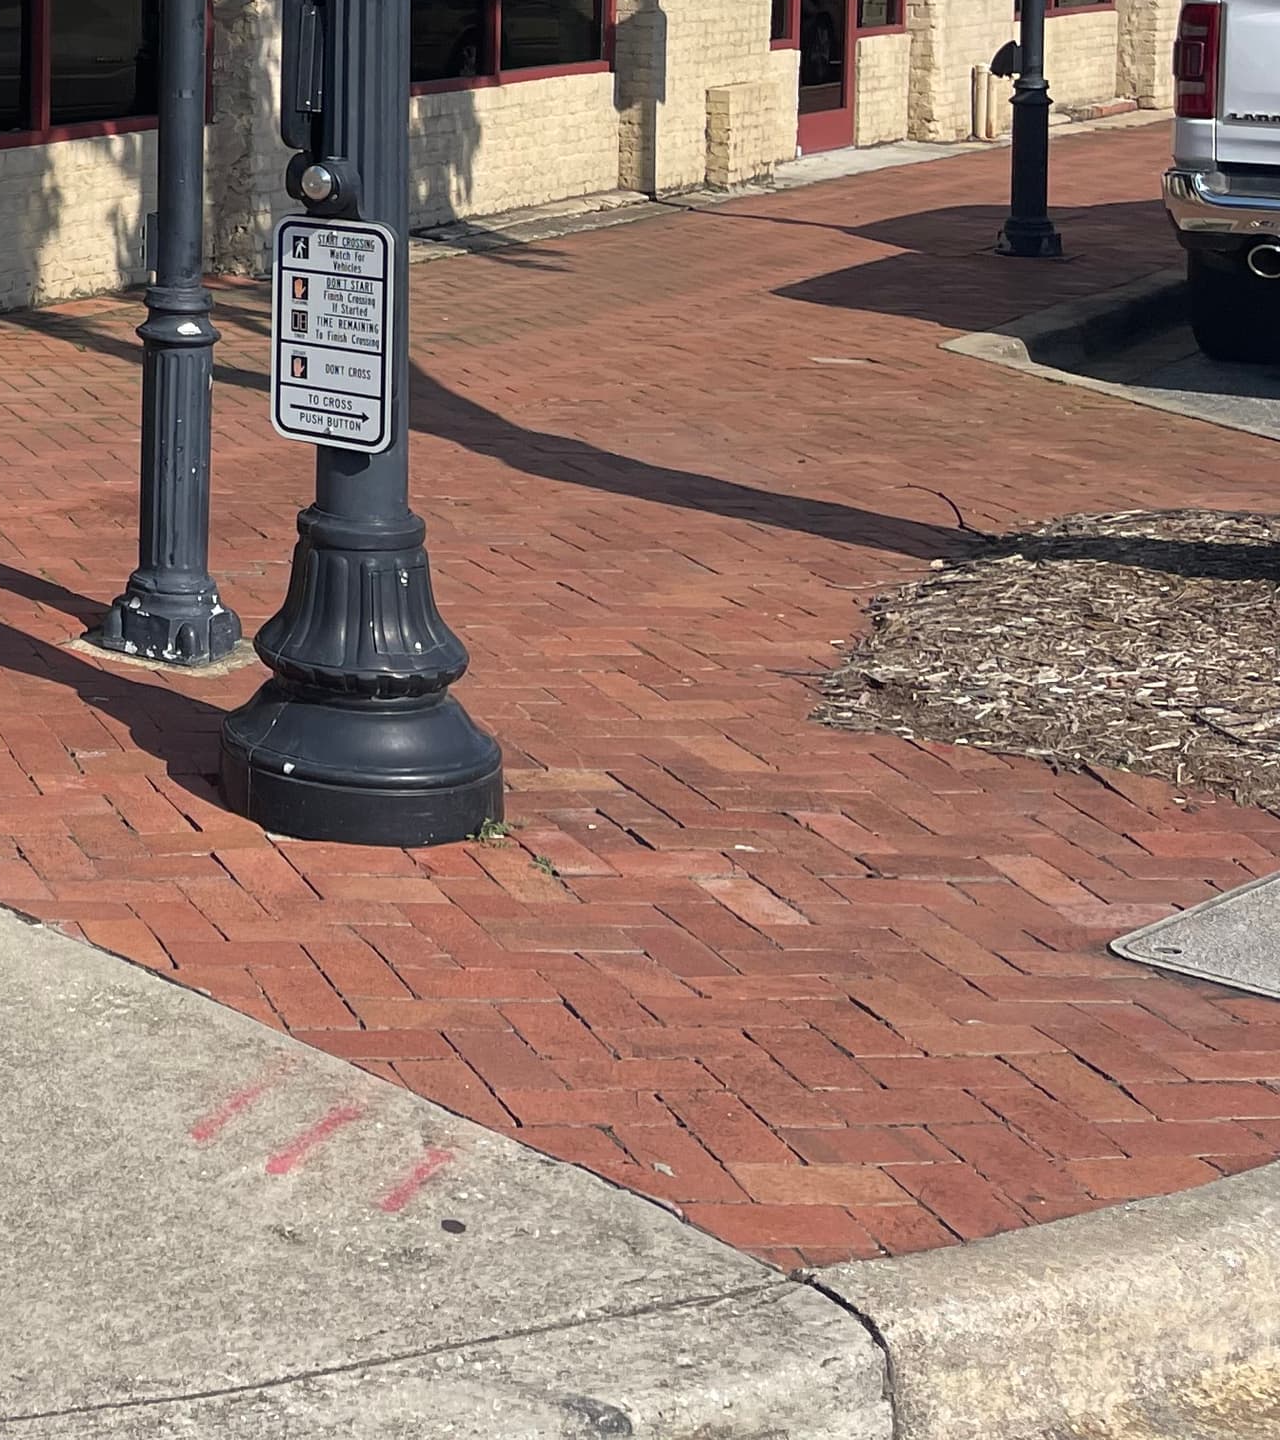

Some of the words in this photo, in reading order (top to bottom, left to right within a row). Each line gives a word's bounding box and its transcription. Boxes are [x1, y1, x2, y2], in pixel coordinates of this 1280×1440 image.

[317, 234, 338, 246] START
[342, 236, 375, 250] CROSSING
[329, 249, 351, 261] Watch
[354, 251, 366, 262] For
[333, 261, 362, 273] Vehicles
[351, 279, 374, 293] START
[323, 290, 344, 302] Finish
[347, 293, 376, 309] Crossing
[341, 303, 368, 317] Started
[316, 315, 333, 328] TIME
[338, 319, 379, 335] REMAINING
[315, 329, 323, 340] To
[327, 330, 347, 343] Finish
[351, 334, 380, 350] Crossing
[348, 366, 372, 380] CROSS
[308, 393, 320, 405] TO
[323, 396, 353, 411] CROSS
[299, 412, 324, 425] PUSH
[327, 416, 362, 432] BUTTON
